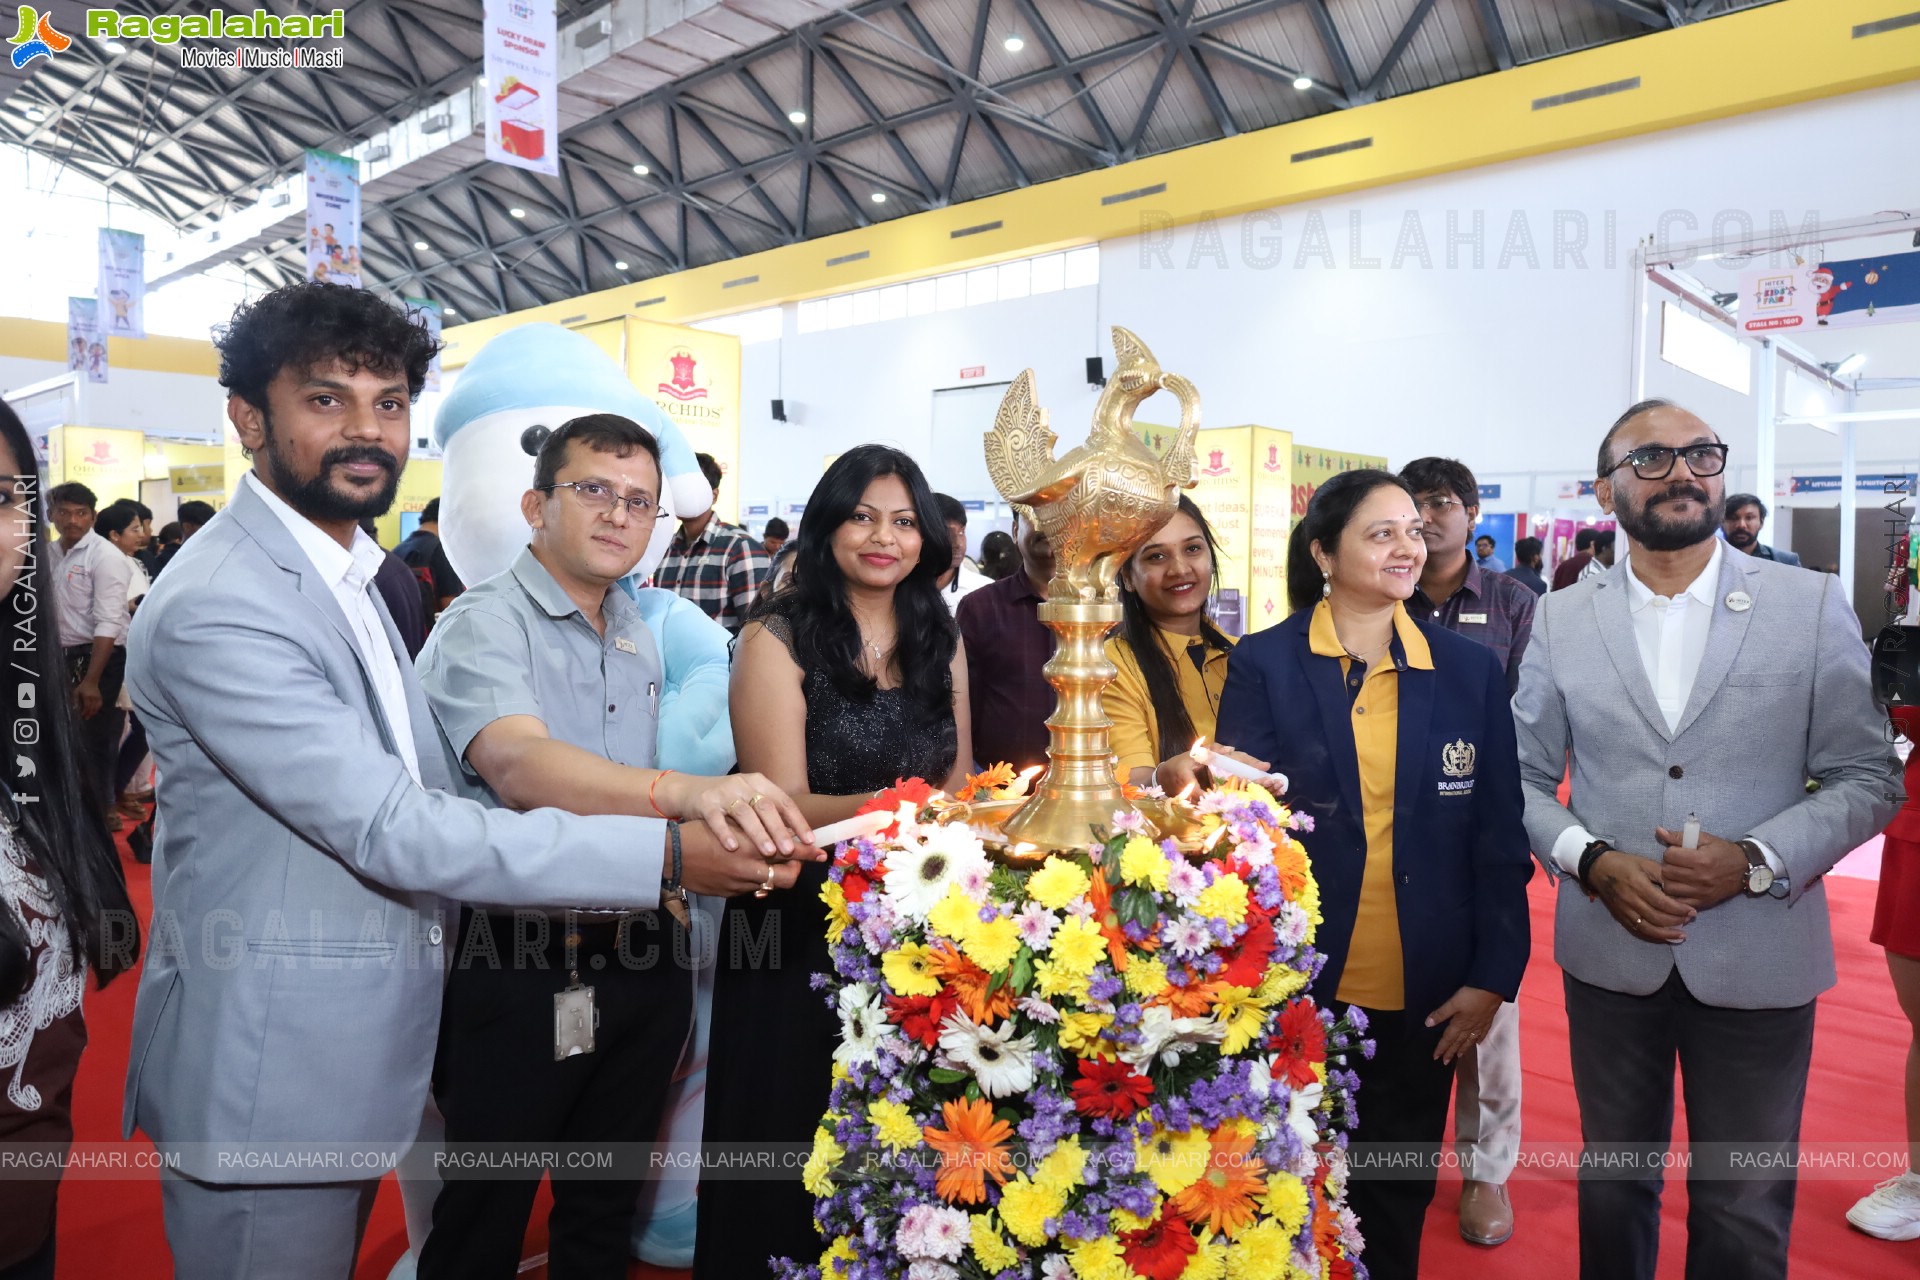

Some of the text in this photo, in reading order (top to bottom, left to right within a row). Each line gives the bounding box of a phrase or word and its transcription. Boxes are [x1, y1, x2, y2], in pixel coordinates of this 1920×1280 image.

[497, 27, 521, 41] LUCKY
[503, 40, 540, 57] SPONSOR
[656, 400, 721, 418] RCHIDS
[1252, 547, 1274, 561] every
